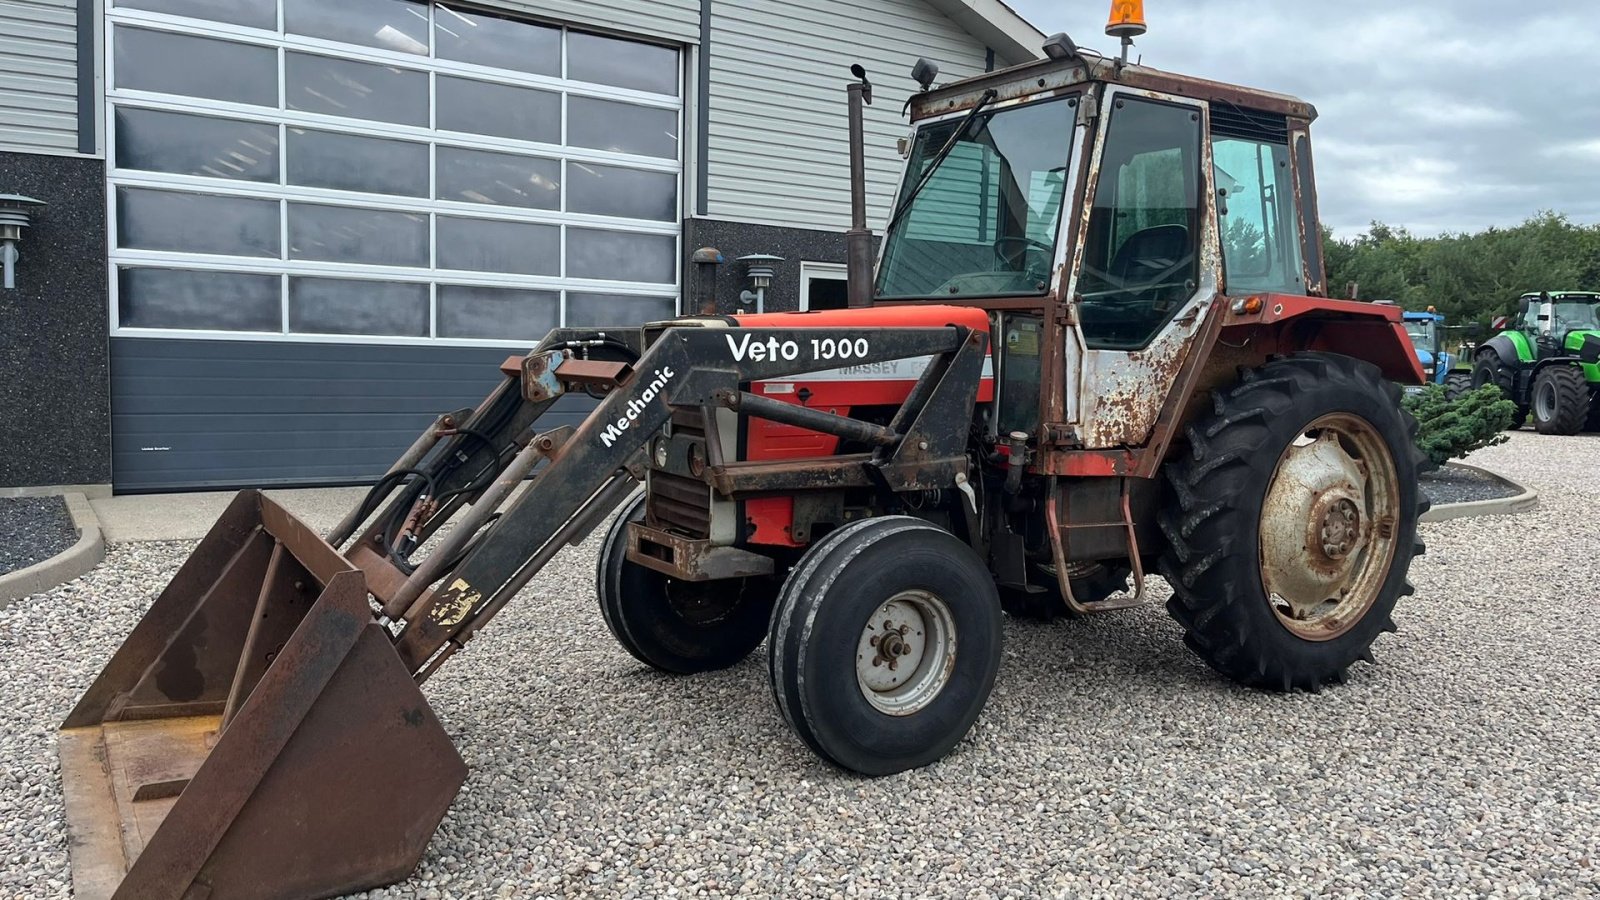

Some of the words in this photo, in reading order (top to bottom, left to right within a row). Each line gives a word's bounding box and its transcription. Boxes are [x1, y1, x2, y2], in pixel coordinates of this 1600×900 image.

[725, 333, 799, 362] Veto
[811, 338, 869, 360] 1000
[600, 366, 675, 448] Mechanic
